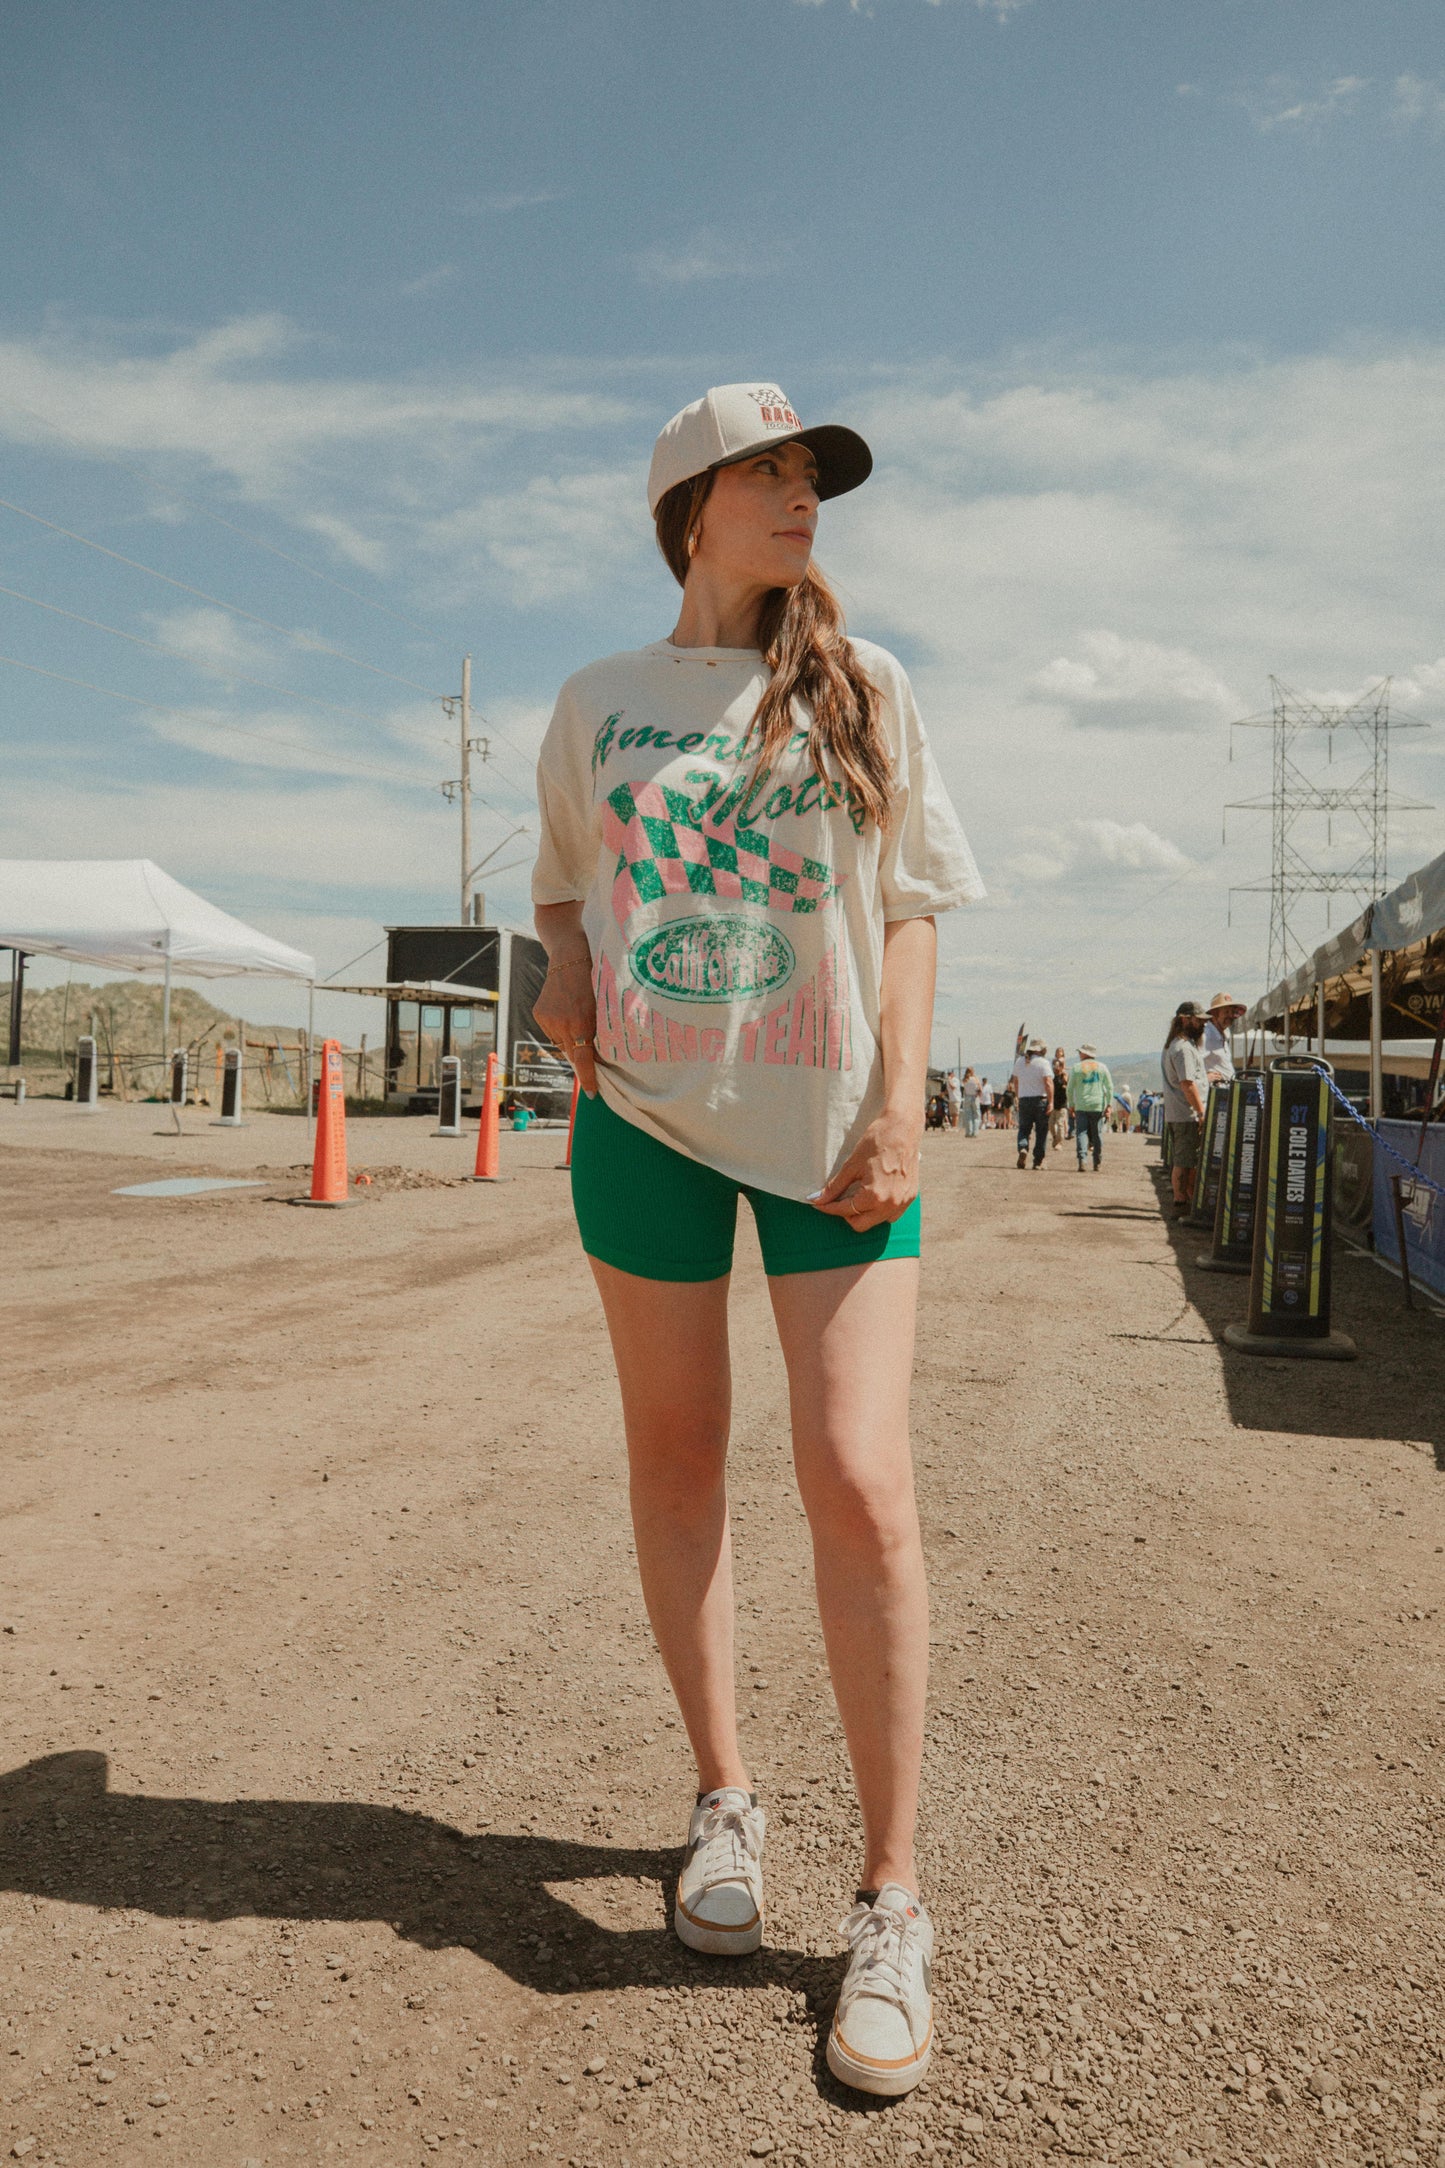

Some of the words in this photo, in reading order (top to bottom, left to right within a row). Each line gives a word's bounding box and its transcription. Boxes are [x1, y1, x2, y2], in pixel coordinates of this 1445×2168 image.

[591, 946, 727, 1063] ACING
[739, 942, 853, 1071] TEAM
[1243, 1105, 1258, 1142] MICHAEL
[1290, 1104, 1309, 1124] 37
[1288, 1126, 1308, 1158] COLE
[1286, 1159, 1306, 1203] DAVIES
